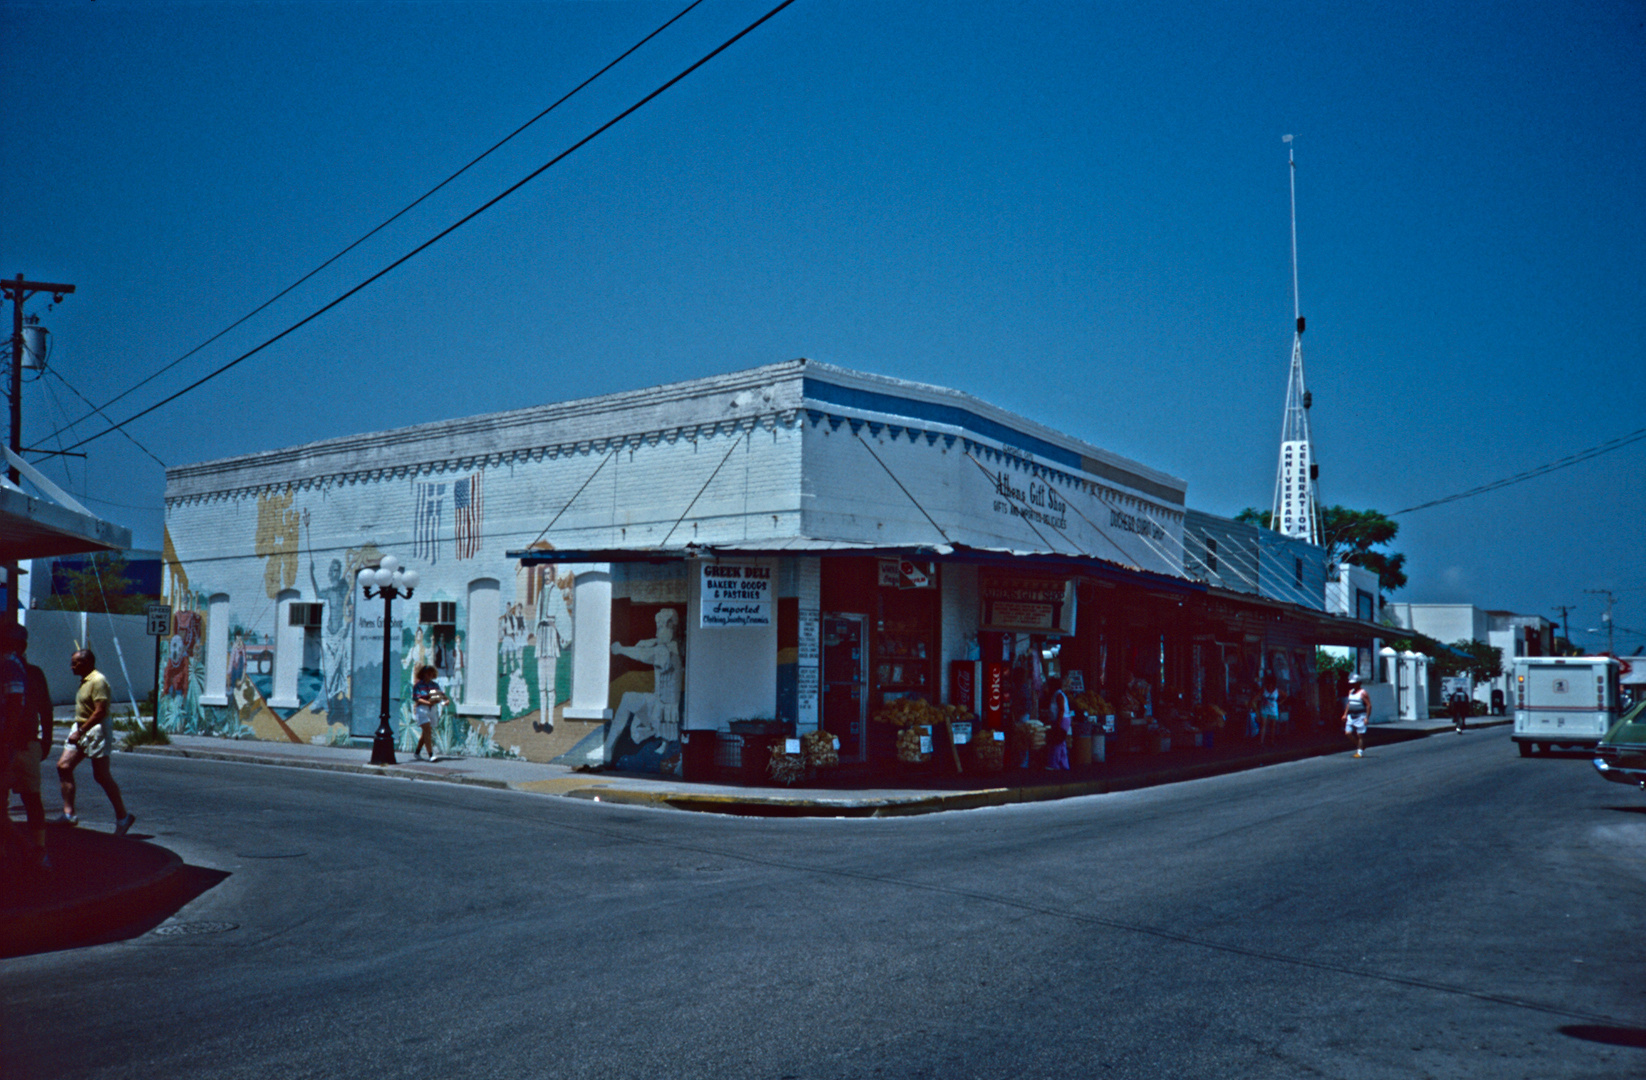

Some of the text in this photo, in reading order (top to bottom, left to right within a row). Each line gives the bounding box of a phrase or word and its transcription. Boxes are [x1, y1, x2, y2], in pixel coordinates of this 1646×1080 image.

[995, 471, 1067, 521] Athens Gift Shop
[993, 500, 1008, 514] GIFTS
[704, 565, 770, 579] GREEK DELI
[707, 580, 767, 590] BAKERY GOODS
[723, 590, 760, 599] PASTRIES
[713, 602, 760, 616] Imported
[151, 620, 167, 633] 15
[989, 667, 1001, 711] Coke
